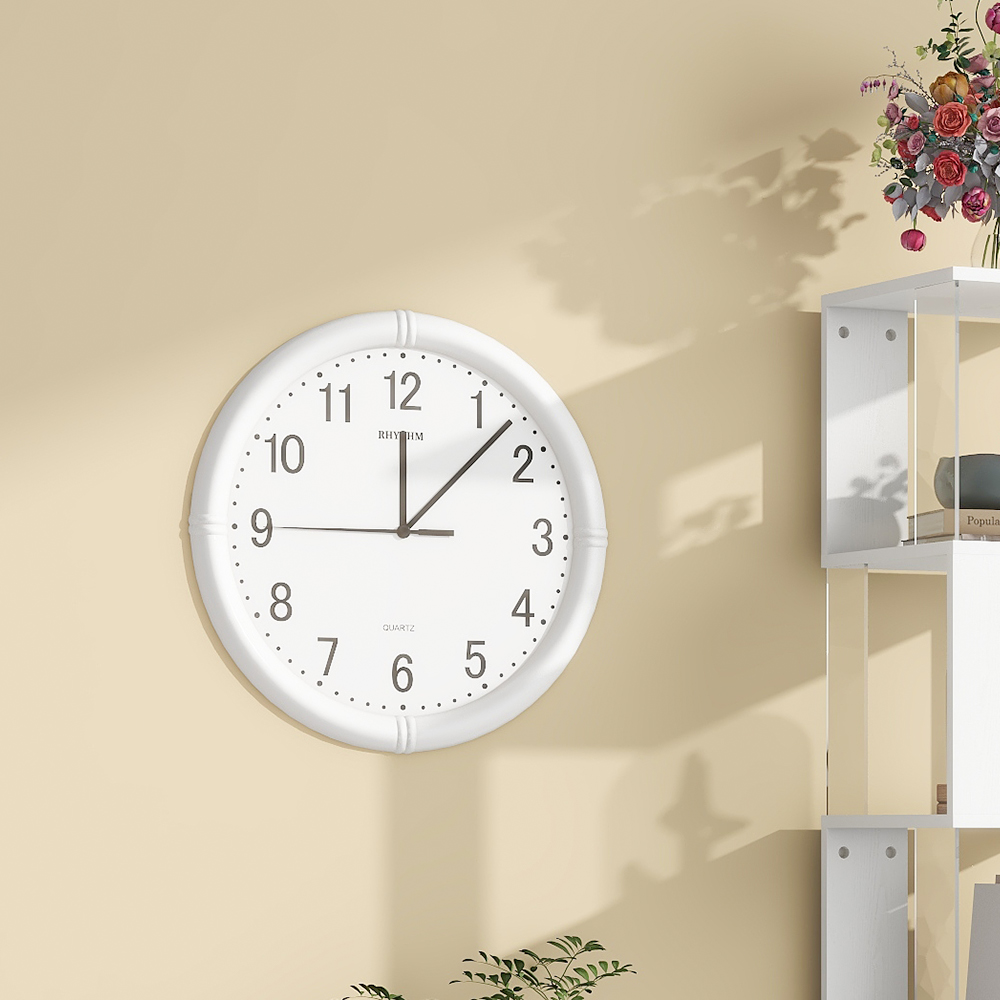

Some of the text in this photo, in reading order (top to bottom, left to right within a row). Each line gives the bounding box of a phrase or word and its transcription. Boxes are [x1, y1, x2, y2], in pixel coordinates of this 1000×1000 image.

[318, 382, 351, 423] 11
[383, 370, 422, 411] 12
[470, 390, 483, 429] 1
[264, 433, 305, 475] 10
[378, 430, 424, 441] RHYHM
[512, 444, 535, 484] 2
[250, 507, 274, 548] 9
[531, 517, 554, 557] 3
[269, 581, 293, 622] 8
[511, 588, 535, 628] 4
[382, 623, 415, 632] QUARTZ
[317, 636, 339, 676] 7
[391, 653, 414, 693] 6
[464, 640, 487, 679] 5
